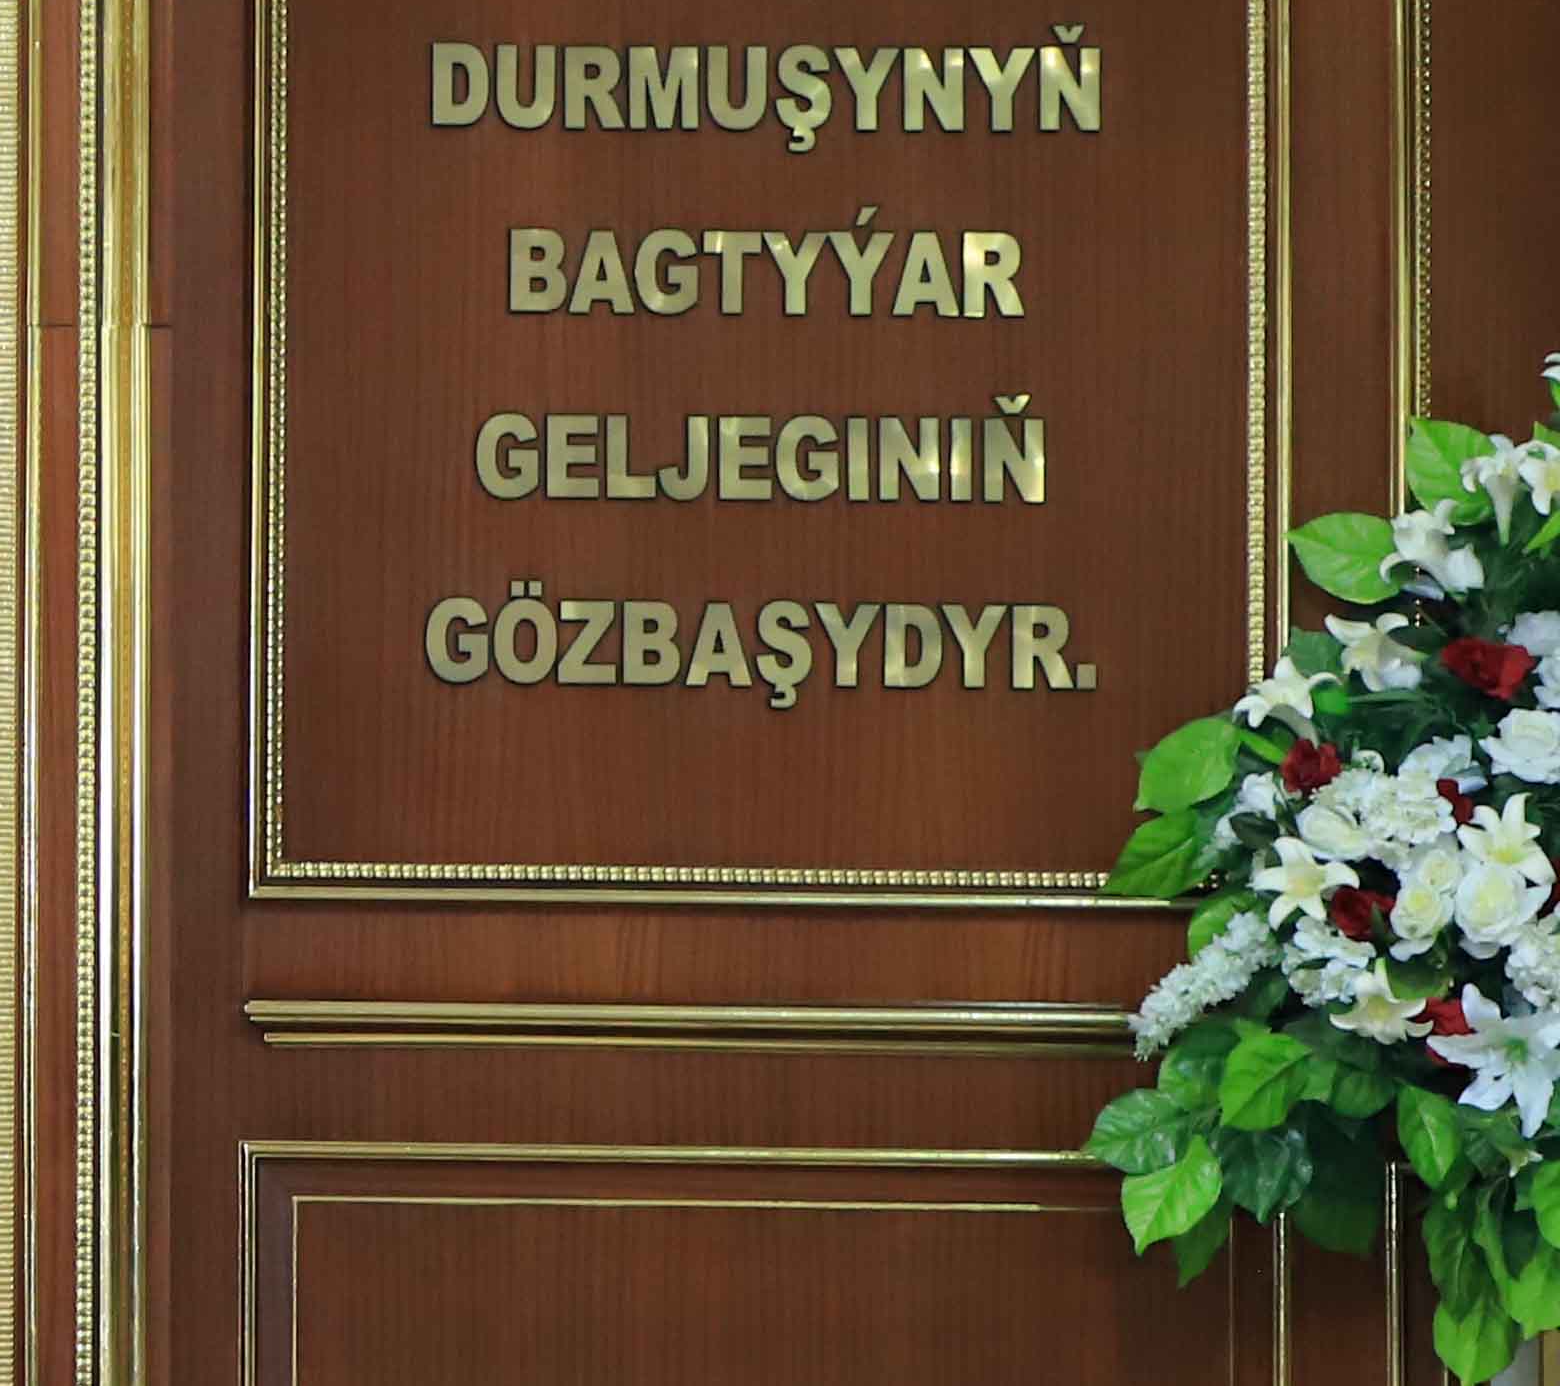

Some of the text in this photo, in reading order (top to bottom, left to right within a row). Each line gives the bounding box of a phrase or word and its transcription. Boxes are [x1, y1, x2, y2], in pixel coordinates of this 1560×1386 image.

[431, 24, 1102, 153] DURMUŞYNYŇ
[509, 206, 1026, 319] BAGTYÝAR
[475, 393, 1047, 504] GELJEGINIŇ
[425, 580, 1097, 709] GÖZBAŞYDYR.
